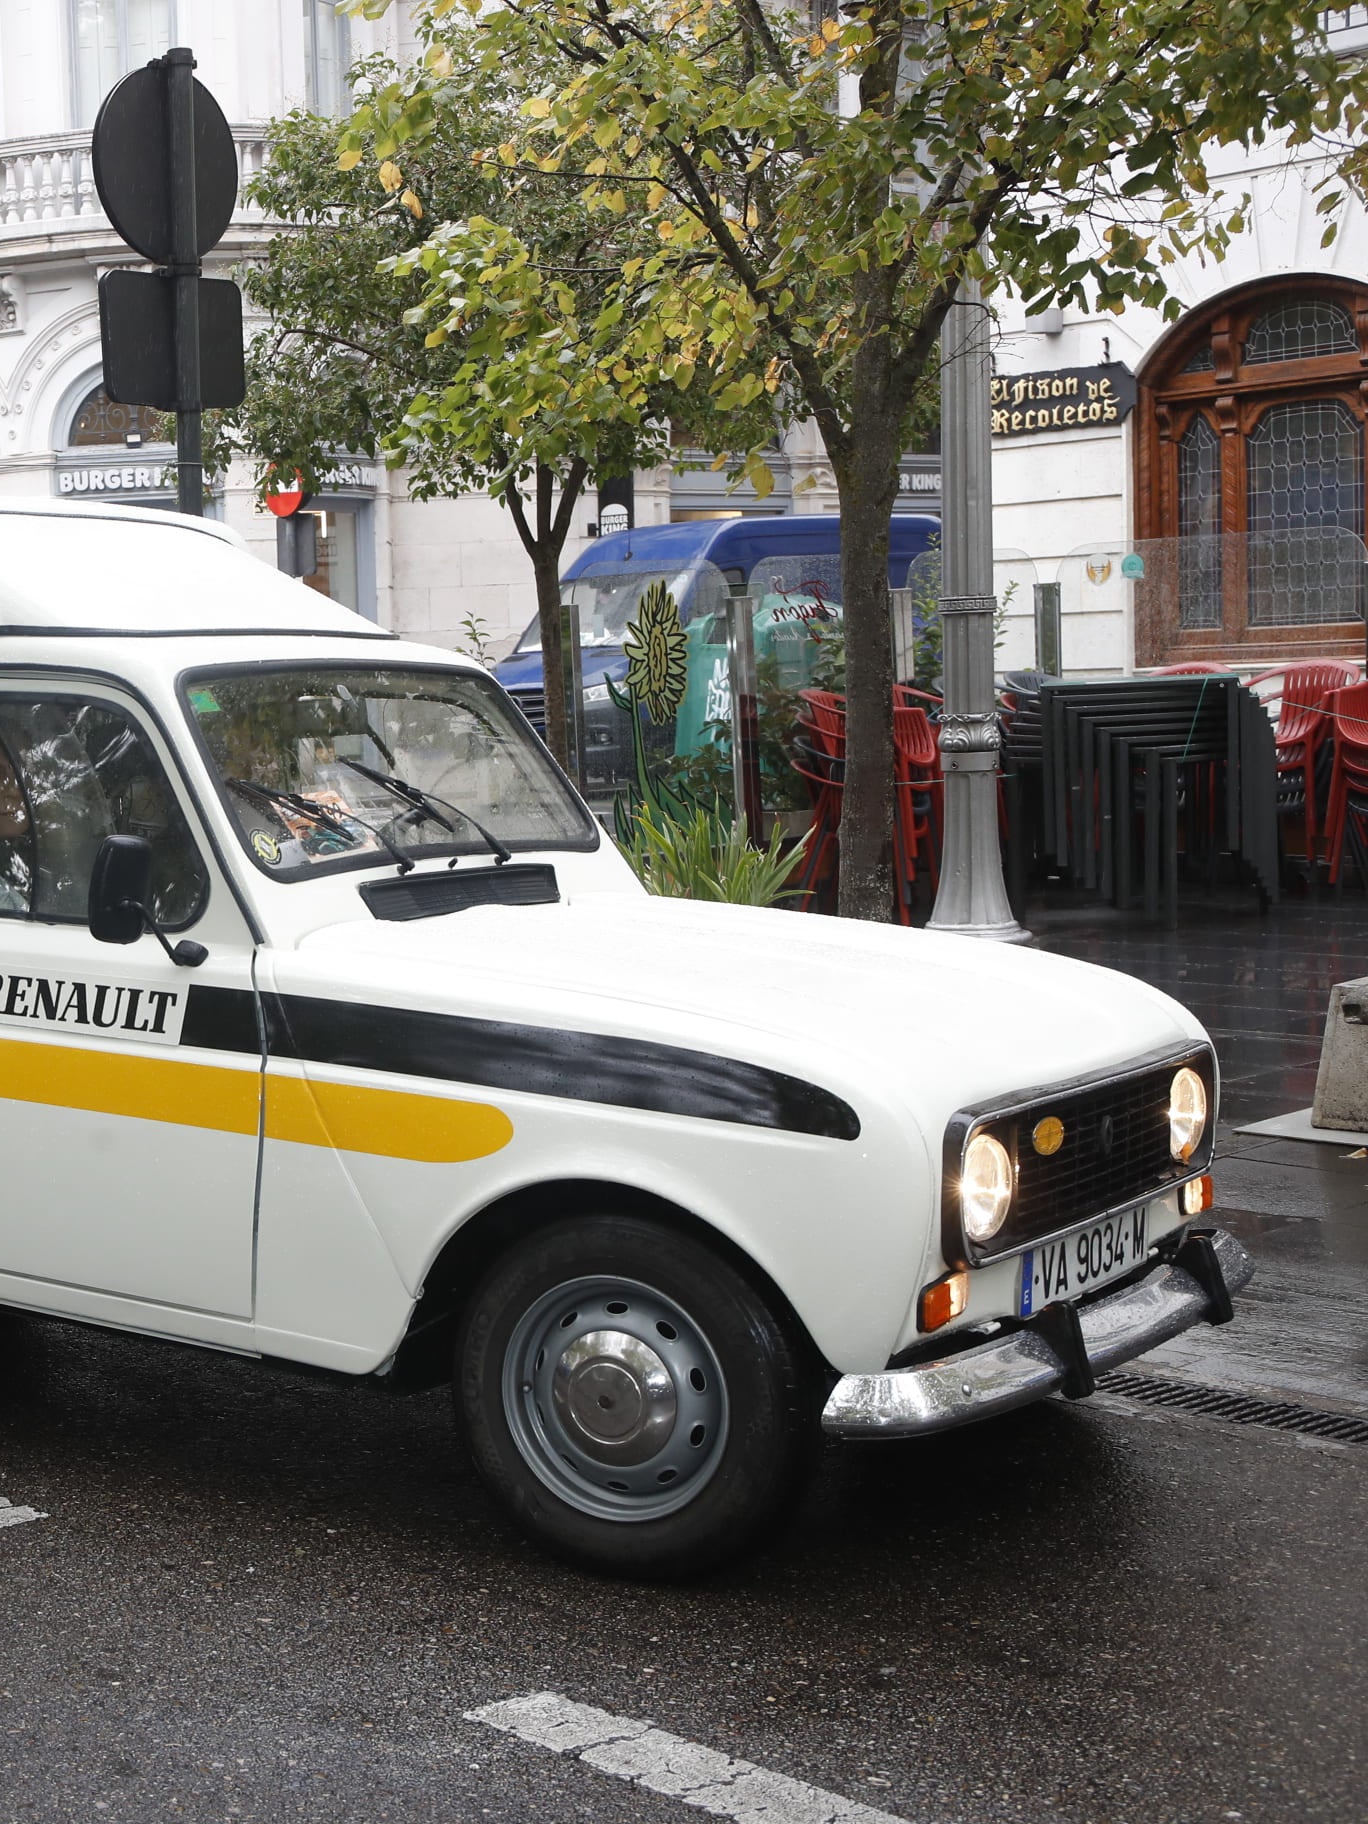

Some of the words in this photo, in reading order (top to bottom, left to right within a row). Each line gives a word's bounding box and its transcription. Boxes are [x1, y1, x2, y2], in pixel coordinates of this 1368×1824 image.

[1085, 377, 1113, 400] de
[991, 396, 1121, 434] Recoletos
[59, 467, 151, 493] BURGER
[912, 473, 942, 490] KING
[601, 514, 629, 525] BURGER
[601, 523, 629, 536] KING
